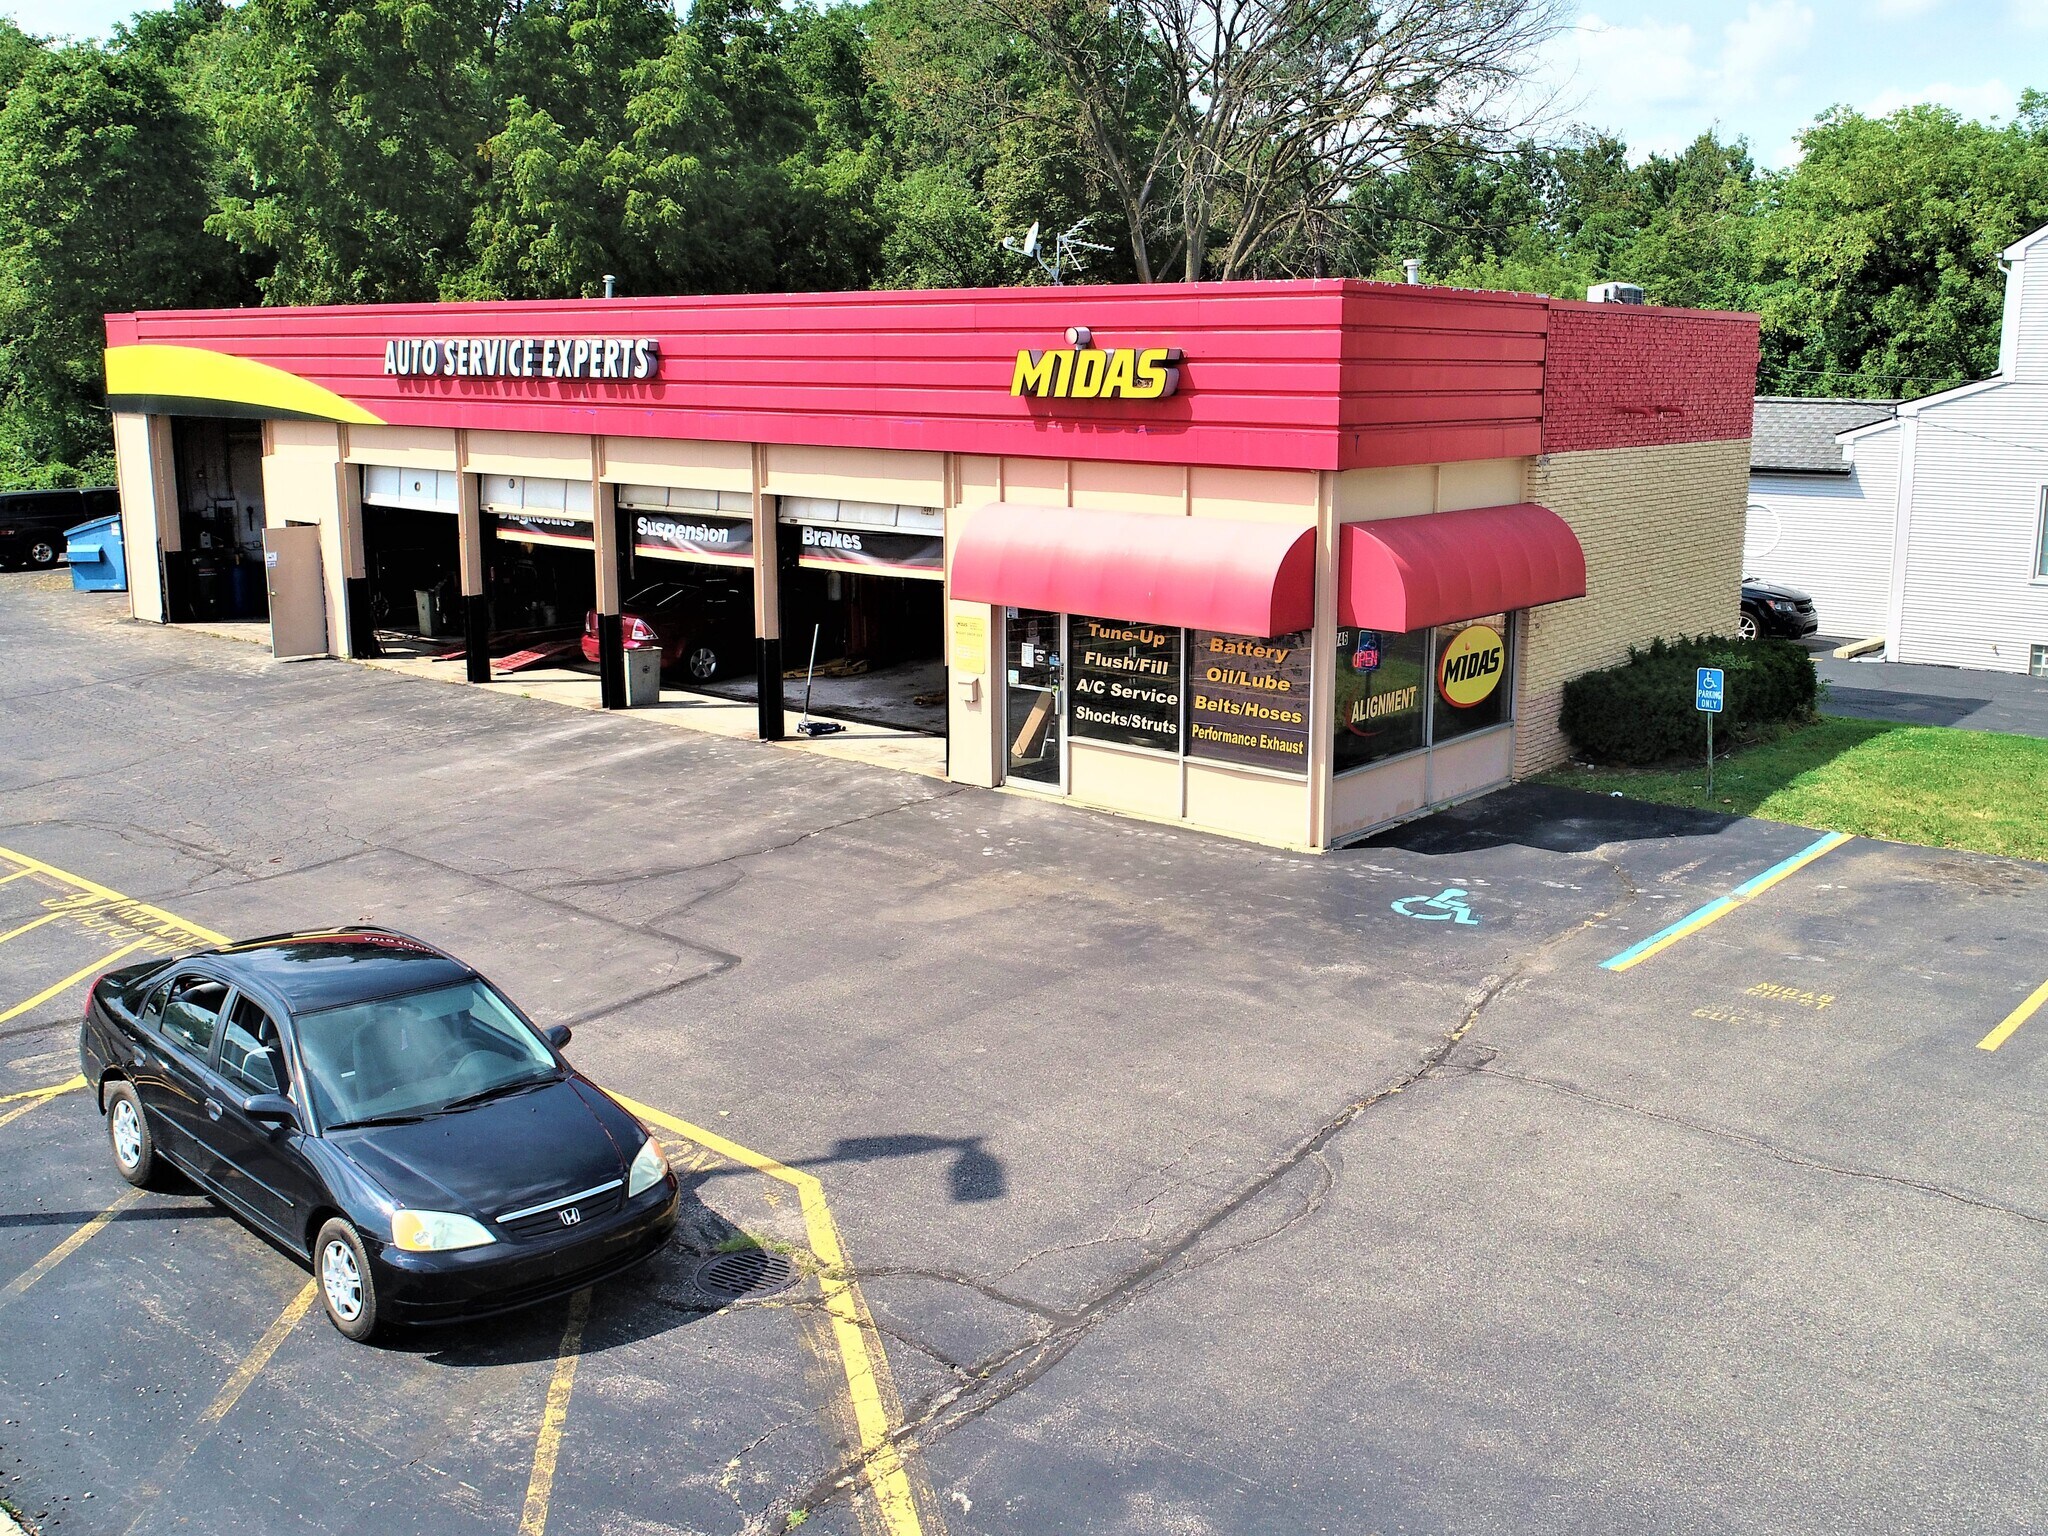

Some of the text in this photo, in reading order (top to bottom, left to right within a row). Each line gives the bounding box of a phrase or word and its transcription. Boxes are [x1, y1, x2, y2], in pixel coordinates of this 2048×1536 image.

[384, 338, 652, 379] AUTO SERVICE EXPERTS
[1010, 348, 1170, 399] MIDAS
[636, 516, 729, 543] Suspension
[802, 526, 862, 551] Brakes
[1088, 623, 1166, 648] Tune-Up
[1084, 651, 1169, 675] Flush/Fill
[1209, 637, 1290, 663] Battery
[1353, 649, 1378, 668] OPEN
[1206, 667, 1291, 691] Oil/Lube
[1443, 646, 1502, 688] MIDAS
[1075, 678, 1179, 706] A/C Service
[1350, 685, 1417, 723] ALIGNMENT
[1698, 689, 1722, 700] PARKING
[1701, 699, 1718, 709] ONLY
[1075, 706, 1178, 734] Shocks/Struts
[1194, 695, 1303, 724] Belts/Hoses
[1191, 723, 1304, 754] Performance Exhaust
